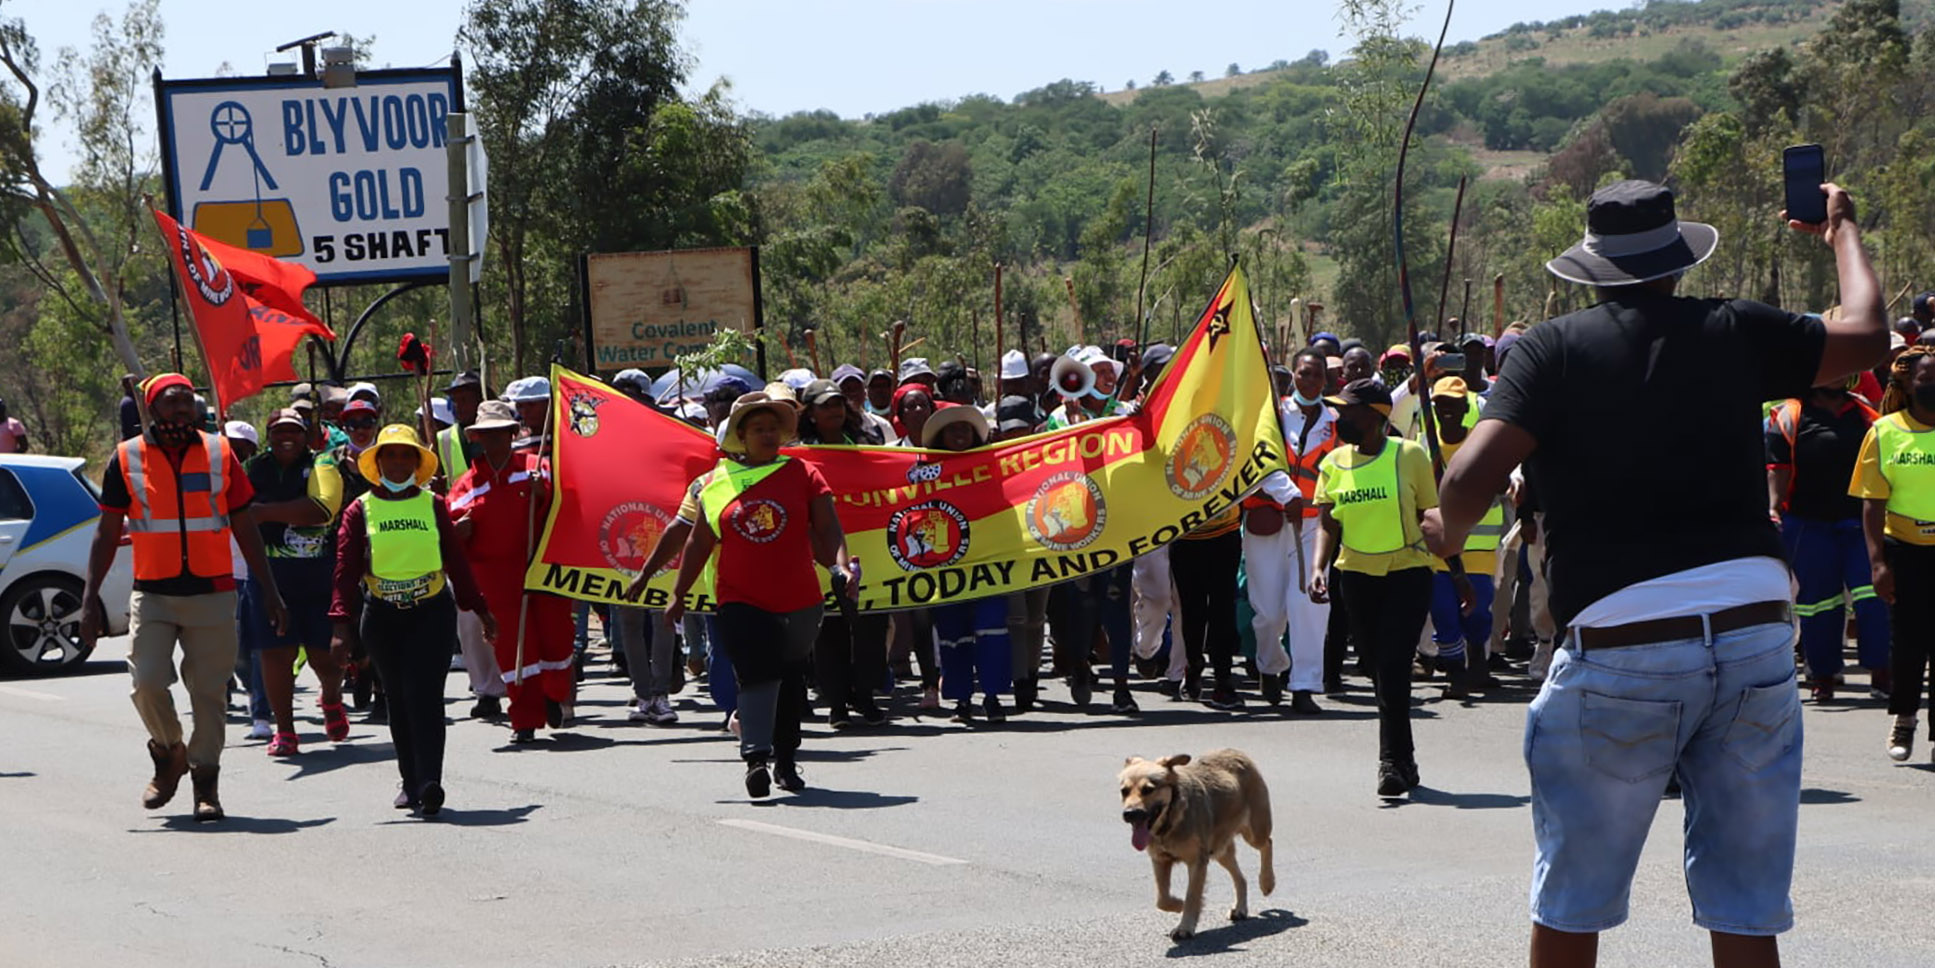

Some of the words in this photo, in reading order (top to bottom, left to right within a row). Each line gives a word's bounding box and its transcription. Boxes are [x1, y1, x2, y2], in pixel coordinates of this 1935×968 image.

[282, 92, 448, 156] BLYVOOR
[329, 167, 424, 222] GOLD
[313, 235, 336, 263] 5
[343, 228, 449, 261] SHAFT
[632, 319, 718, 339] Covalent
[597, 345, 656, 363] Water
[1000, 432, 1133, 476] REGION
[1891, 452, 1935, 465] MARSHA
[1027, 472, 1071, 515] NATIONAL
[1074, 472, 1103, 501] UNION
[379, 518, 428, 532] MARSHALL
[601, 502, 653, 530] NATIONAL
[882, 560, 1017, 606] TODAY
[1030, 549, 1118, 582] AND
[1128, 440, 1278, 556] FOREVER
[939, 502, 968, 530] UNION
[890, 544, 901, 559] OF
